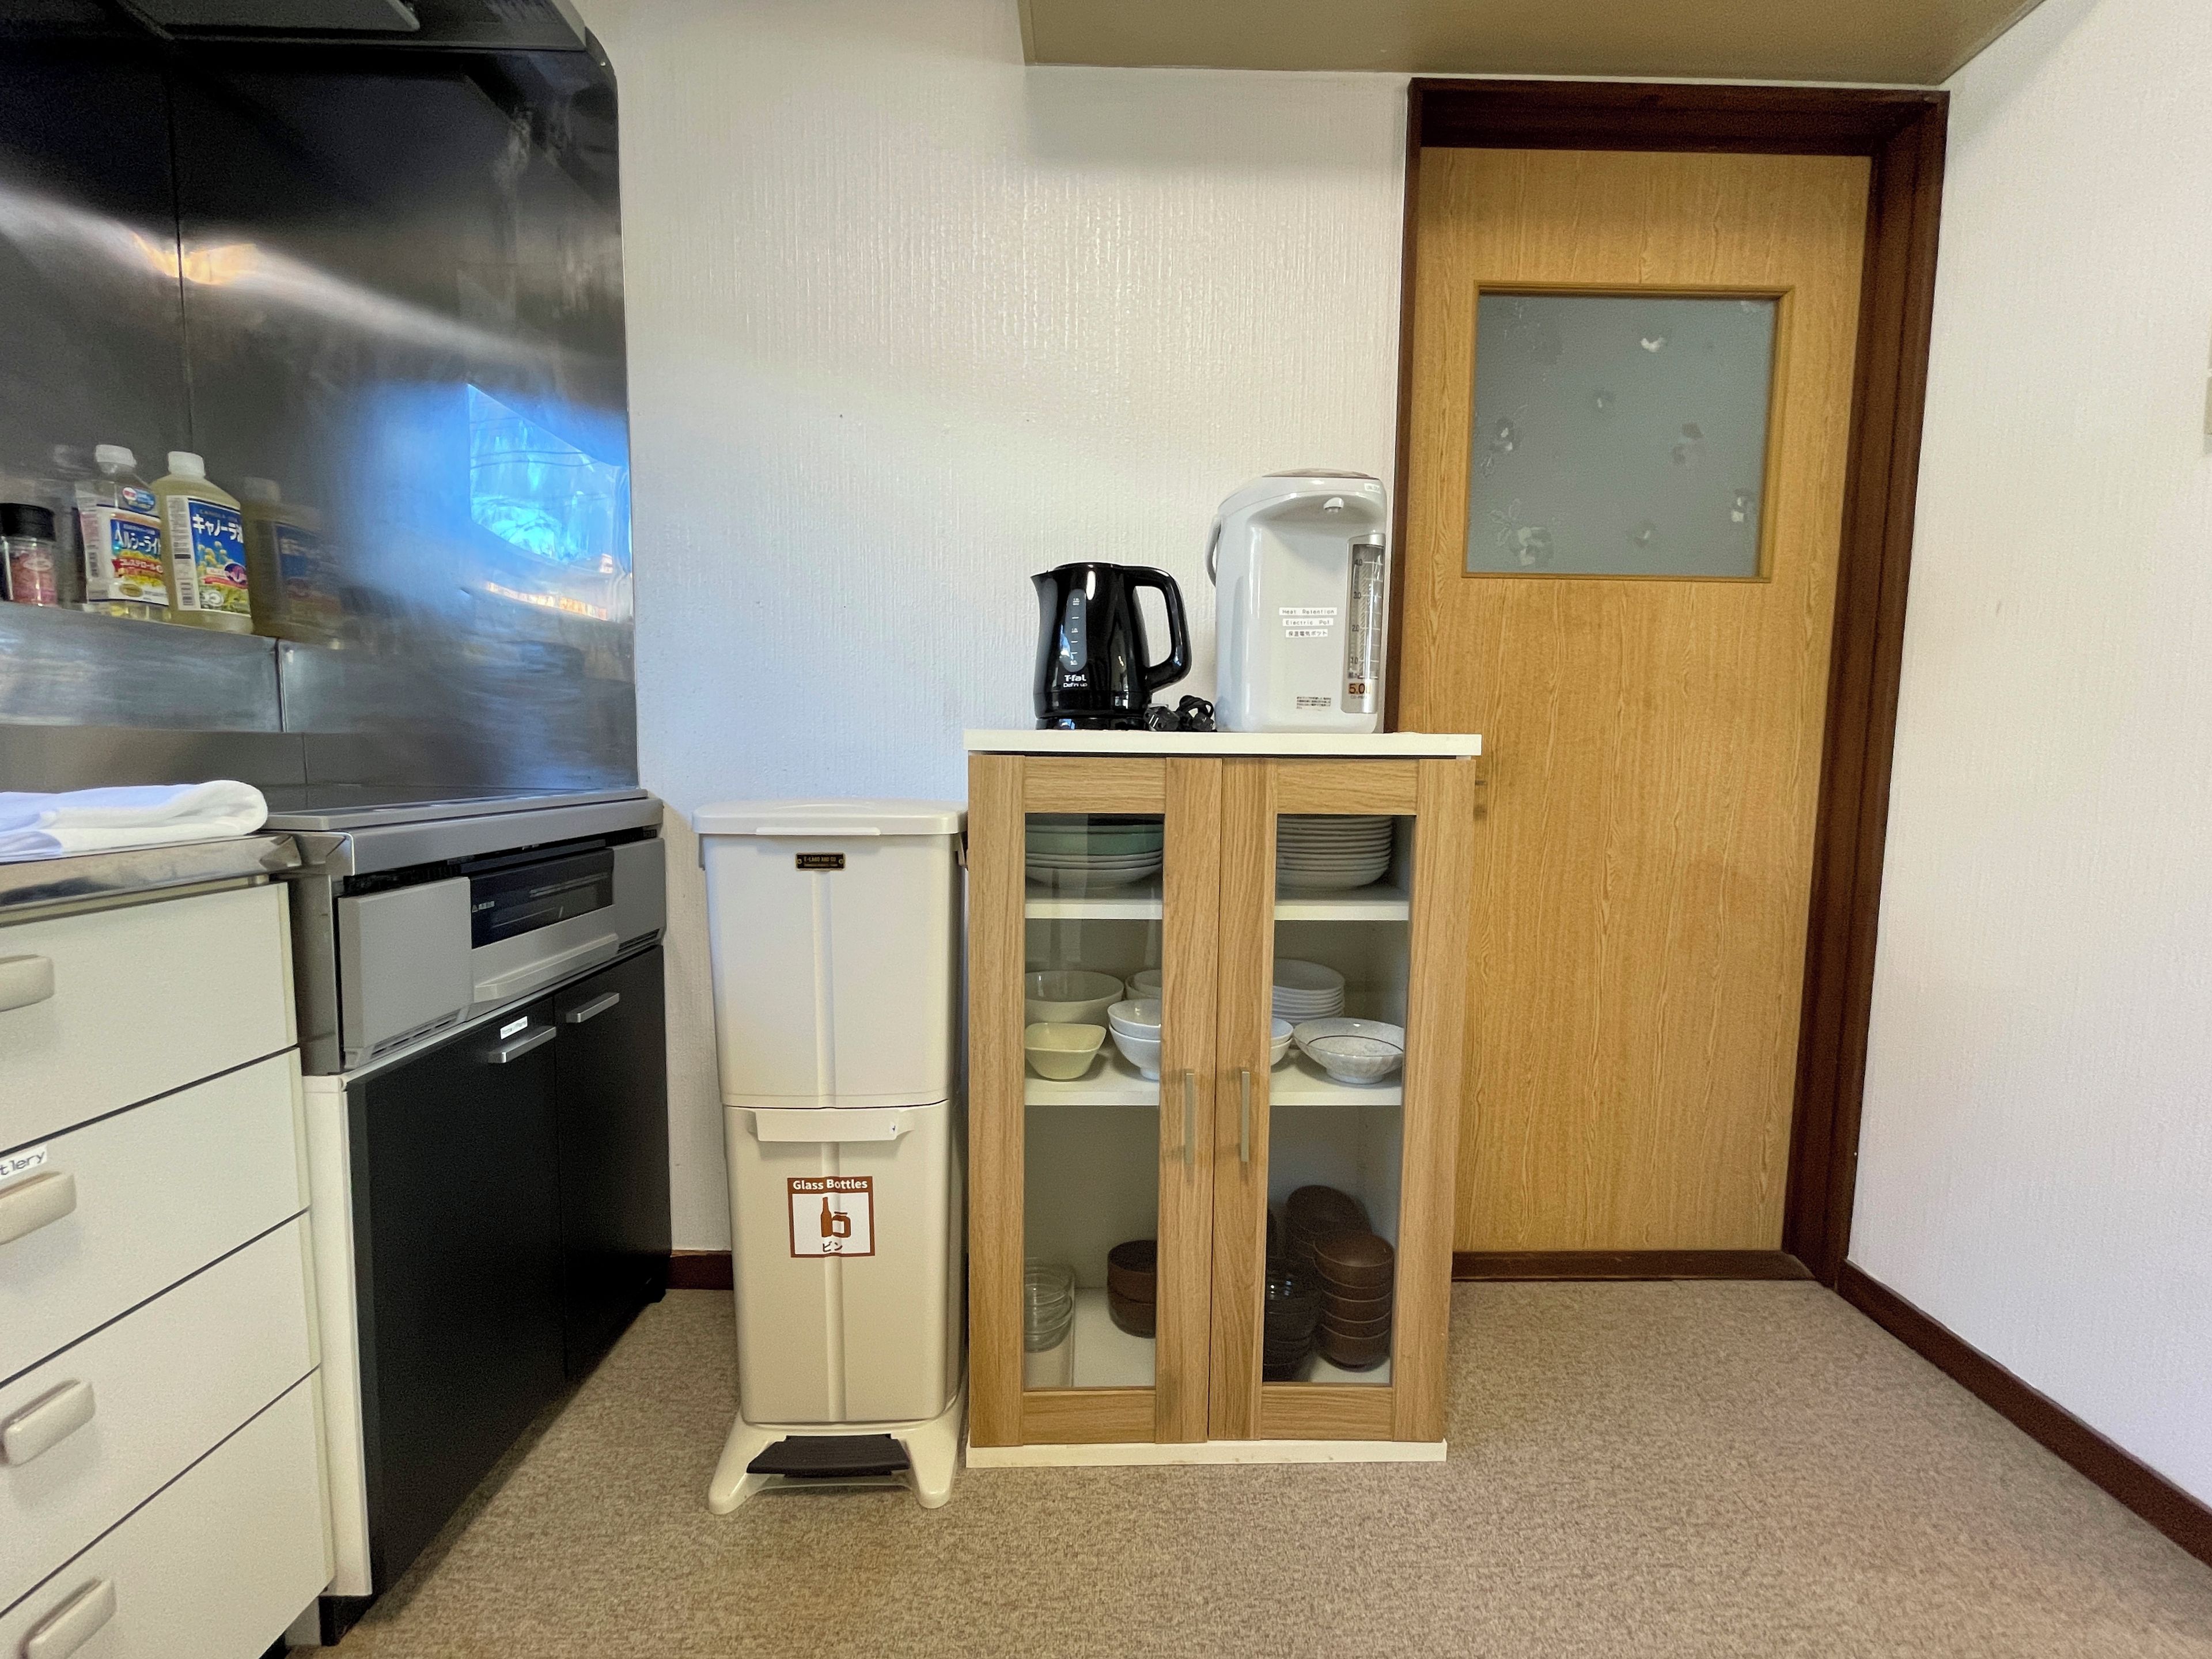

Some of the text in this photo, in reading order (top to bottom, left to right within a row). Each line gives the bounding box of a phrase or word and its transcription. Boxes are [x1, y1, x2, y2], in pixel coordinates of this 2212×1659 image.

[793, 1179, 868, 1190] Glass Bottles
[822, 1241, 843, 1253] ビン
